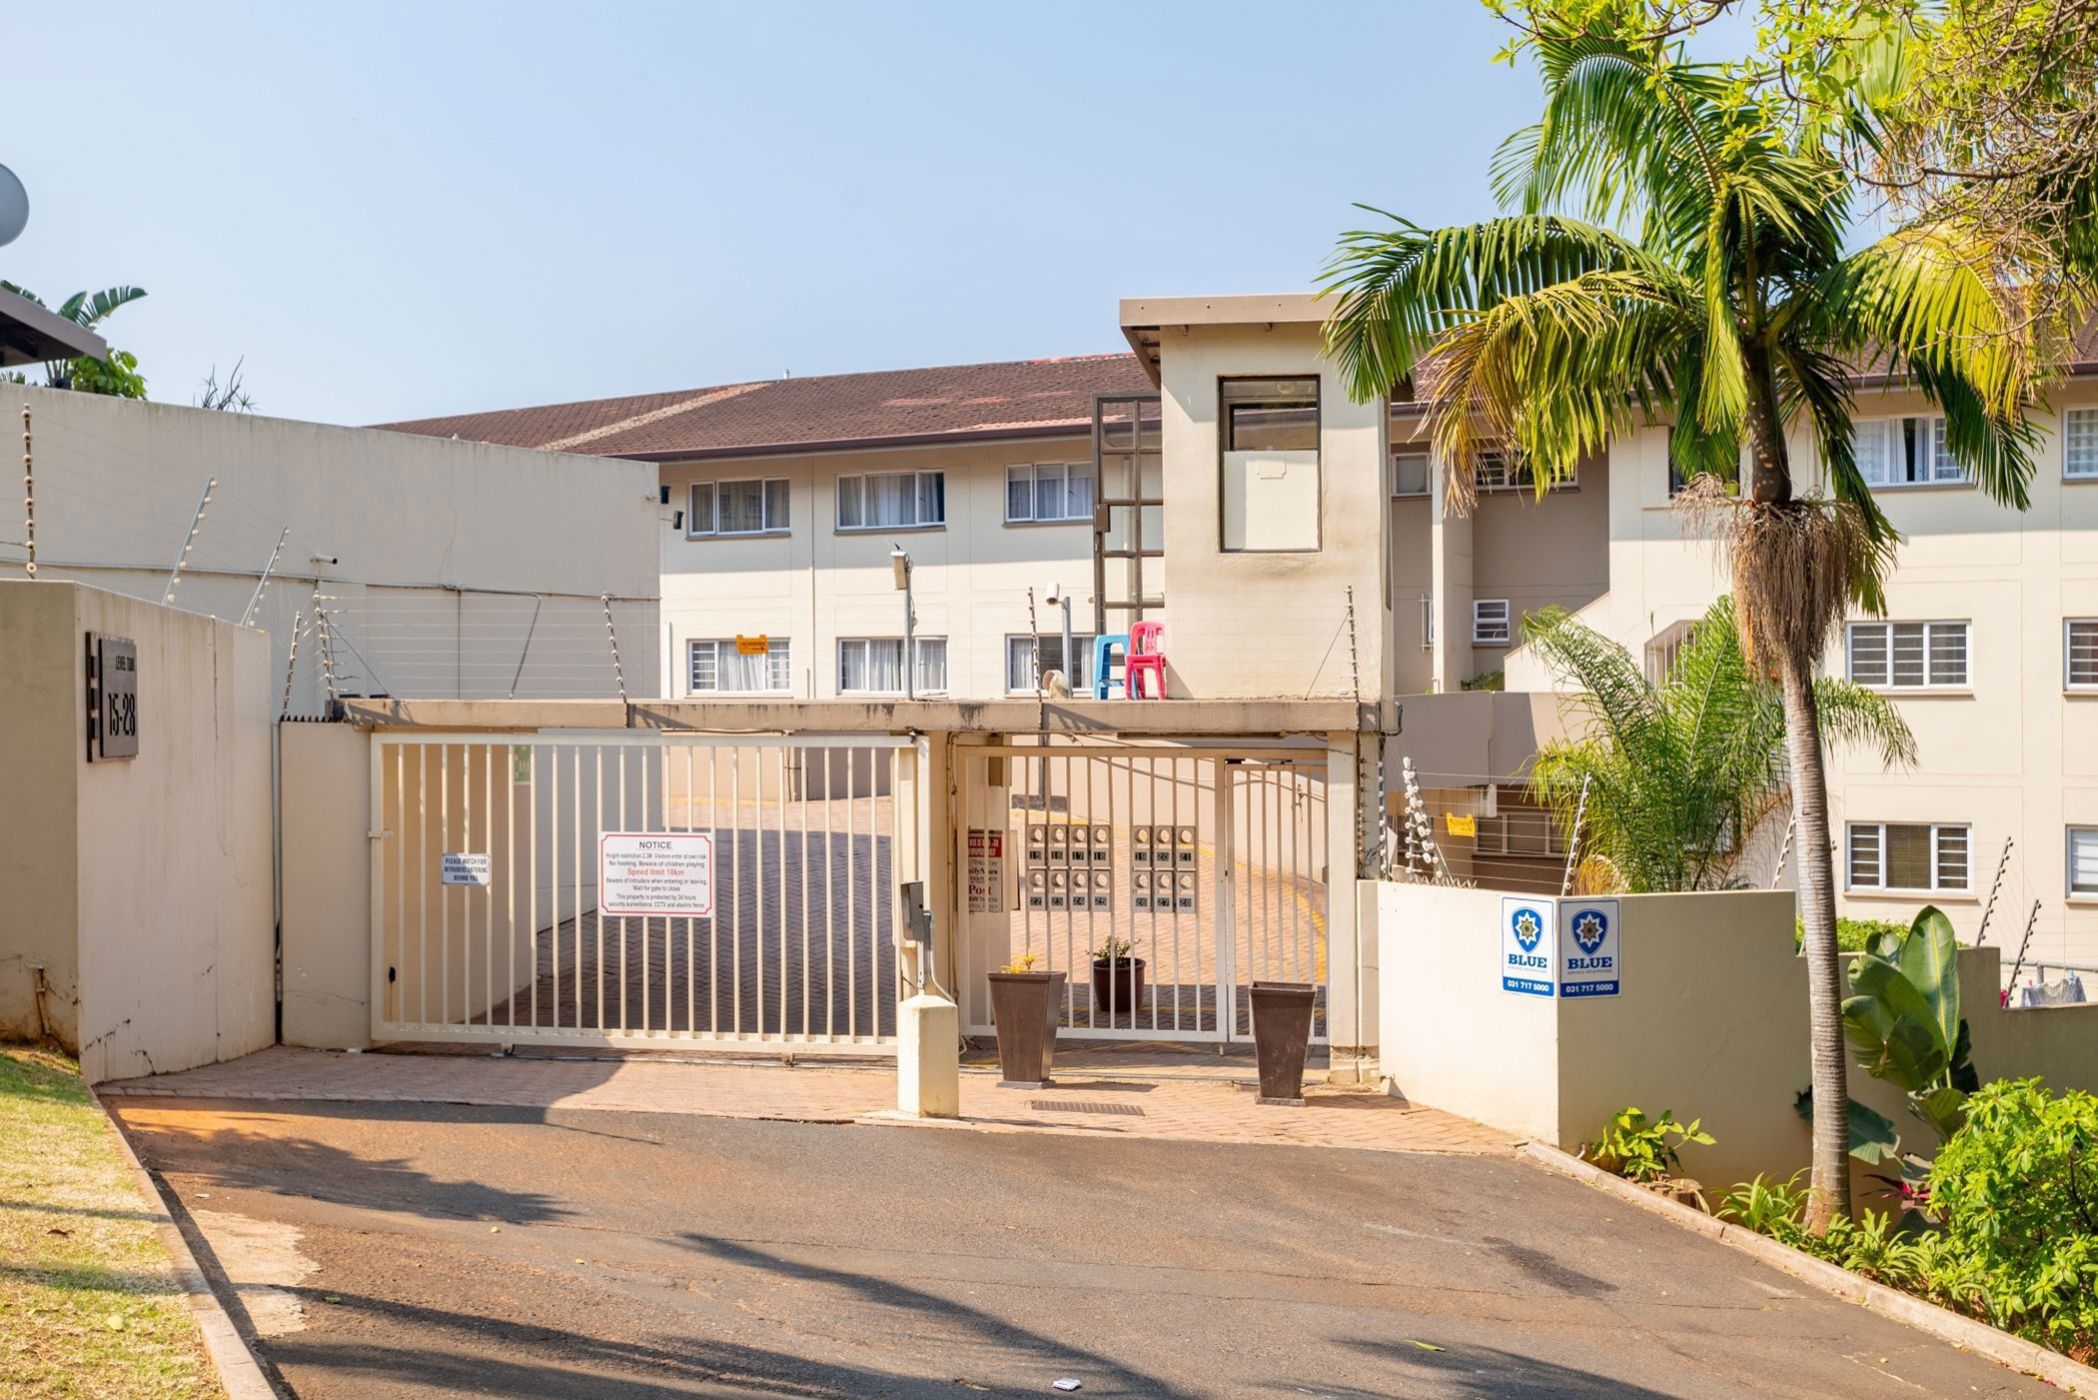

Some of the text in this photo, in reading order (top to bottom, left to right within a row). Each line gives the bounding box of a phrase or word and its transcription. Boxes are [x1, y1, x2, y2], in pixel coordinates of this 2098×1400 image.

[639, 841, 672, 849] NOTICE
[1072, 852, 1084, 860] 17
[1180, 853, 1191, 861] 21
[627, 868, 648, 876] Speed
[1030, 897, 1042, 906] 22
[1157, 897, 1170, 906] 27
[1508, 954, 1547, 968] BLUE
[1568, 957, 1612, 969] BLUE
[1533, 983, 1549, 992] 5000
[1582, 984, 1594, 992] 717
[1596, 983, 1614, 991] 5000
